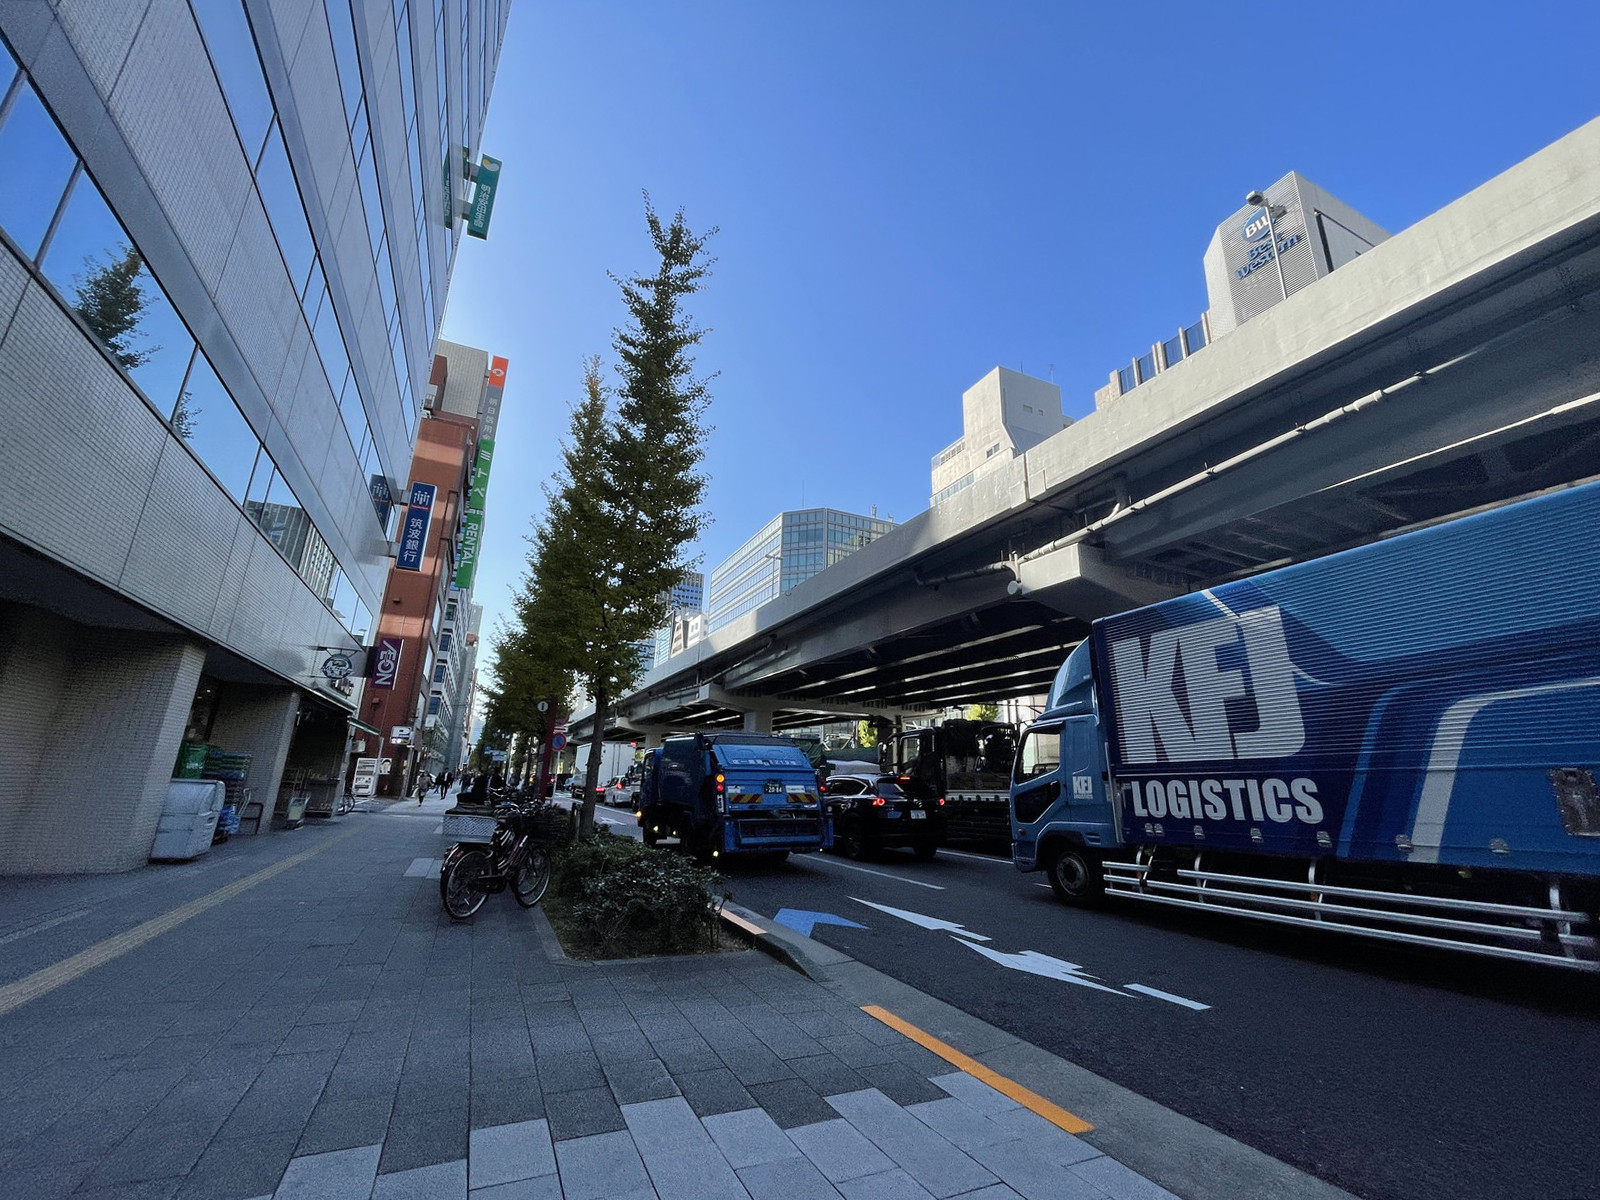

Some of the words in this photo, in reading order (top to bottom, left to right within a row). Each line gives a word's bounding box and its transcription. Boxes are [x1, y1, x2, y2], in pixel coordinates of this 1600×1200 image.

[403, 517, 423, 562] 筑波銀行
[460, 522, 479, 568] RENTAL
[1131, 777, 1324, 824] LOGISTICS
